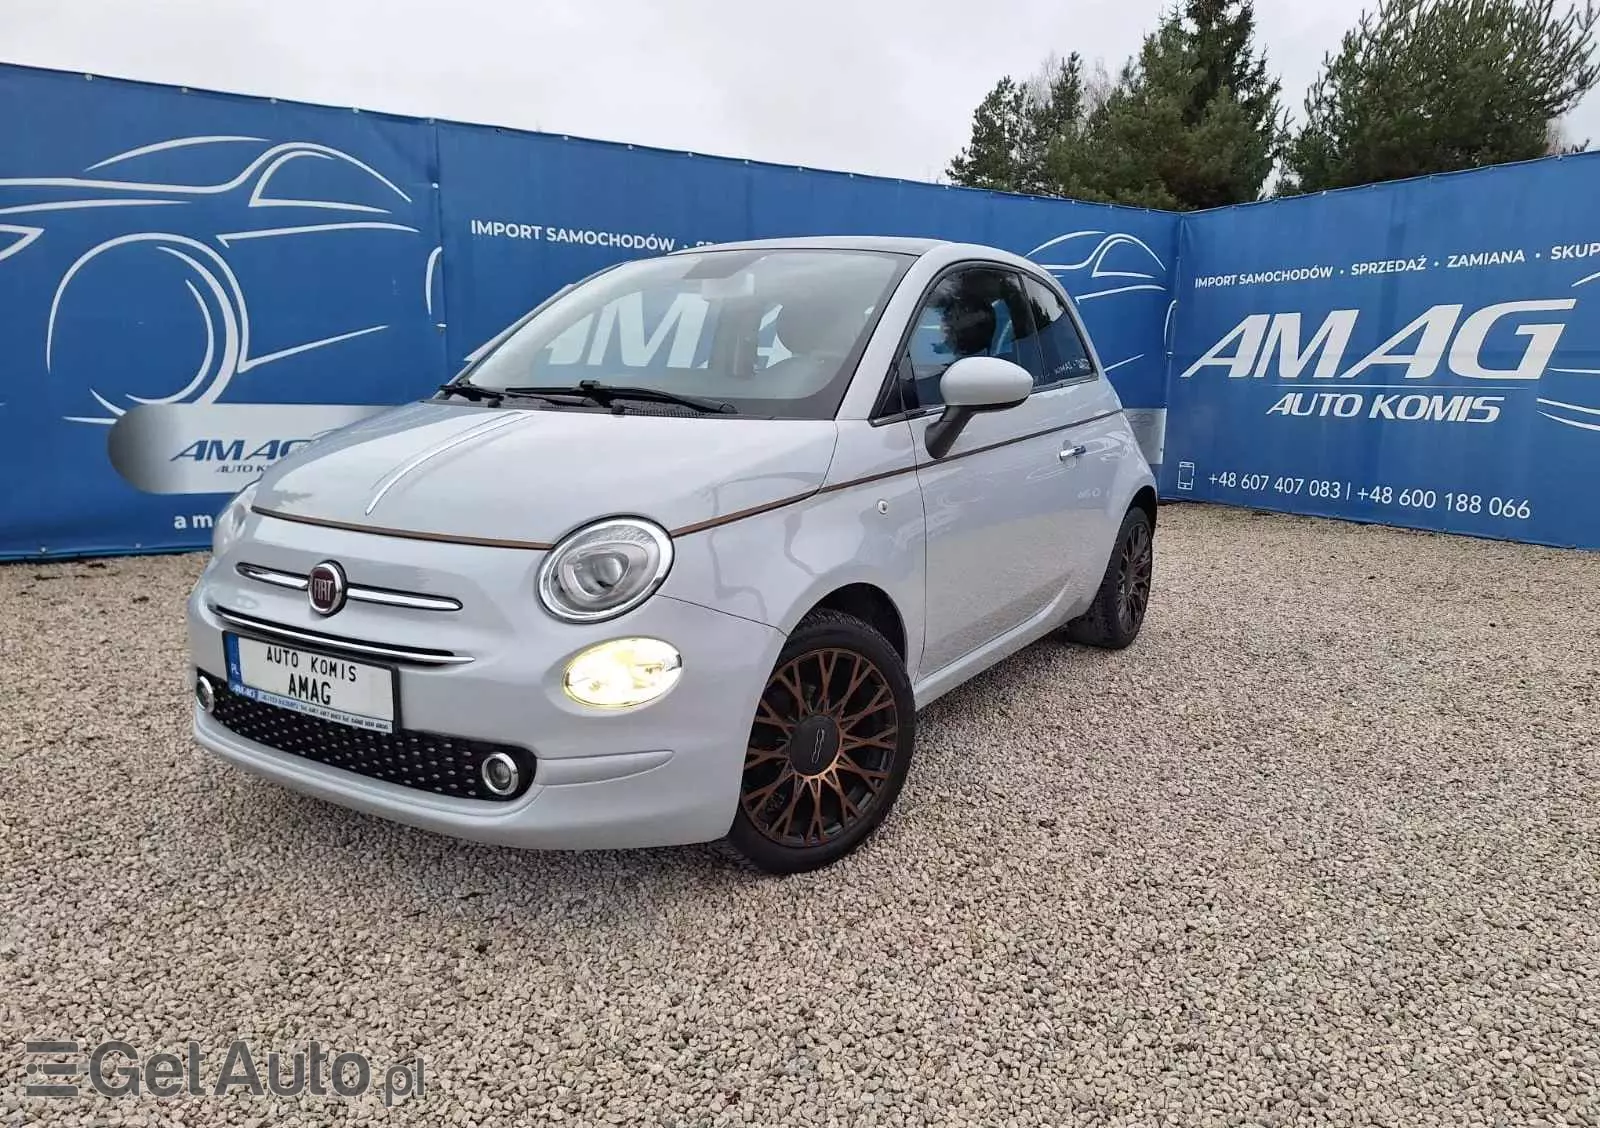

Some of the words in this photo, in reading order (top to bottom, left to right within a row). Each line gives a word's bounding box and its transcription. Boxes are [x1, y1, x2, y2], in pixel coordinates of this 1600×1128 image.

[471, 219, 542, 240] IMPORT
[546, 227, 675, 251] SAMOCHODÓW
[1195, 274, 1237, 288] IMPORT
[1239, 265, 1333, 284] SAMOCHODÓW
[1351, 255, 1428, 275] SPRZEDAŻ
[1447, 249, 1526, 268] ZAMIANA
[1551, 242, 1600, 260] SKUP
[1180, 298, 1576, 380] AMAG
[1266, 392, 1362, 418] AUTO
[1369, 394, 1505, 423] KOMIS
[215, 464, 252, 473] AUTO
[1208, 472, 1237, 488] +48
[1241, 474, 1269, 491] 607
[1274, 477, 1304, 495] 407
[1309, 480, 1341, 499] 083
[1357, 485, 1393, 505] +48
[1398, 488, 1436, 509] 600
[1444, 493, 1482, 514] 188
[1488, 497, 1531, 519] 066
[314, 578, 334, 601] FIAT
[231, 663, 241, 675] PL
[266, 646, 299, 668] AUTO
[311, 656, 357, 682] KOMIS
[288, 673, 332, 705] AMAG
